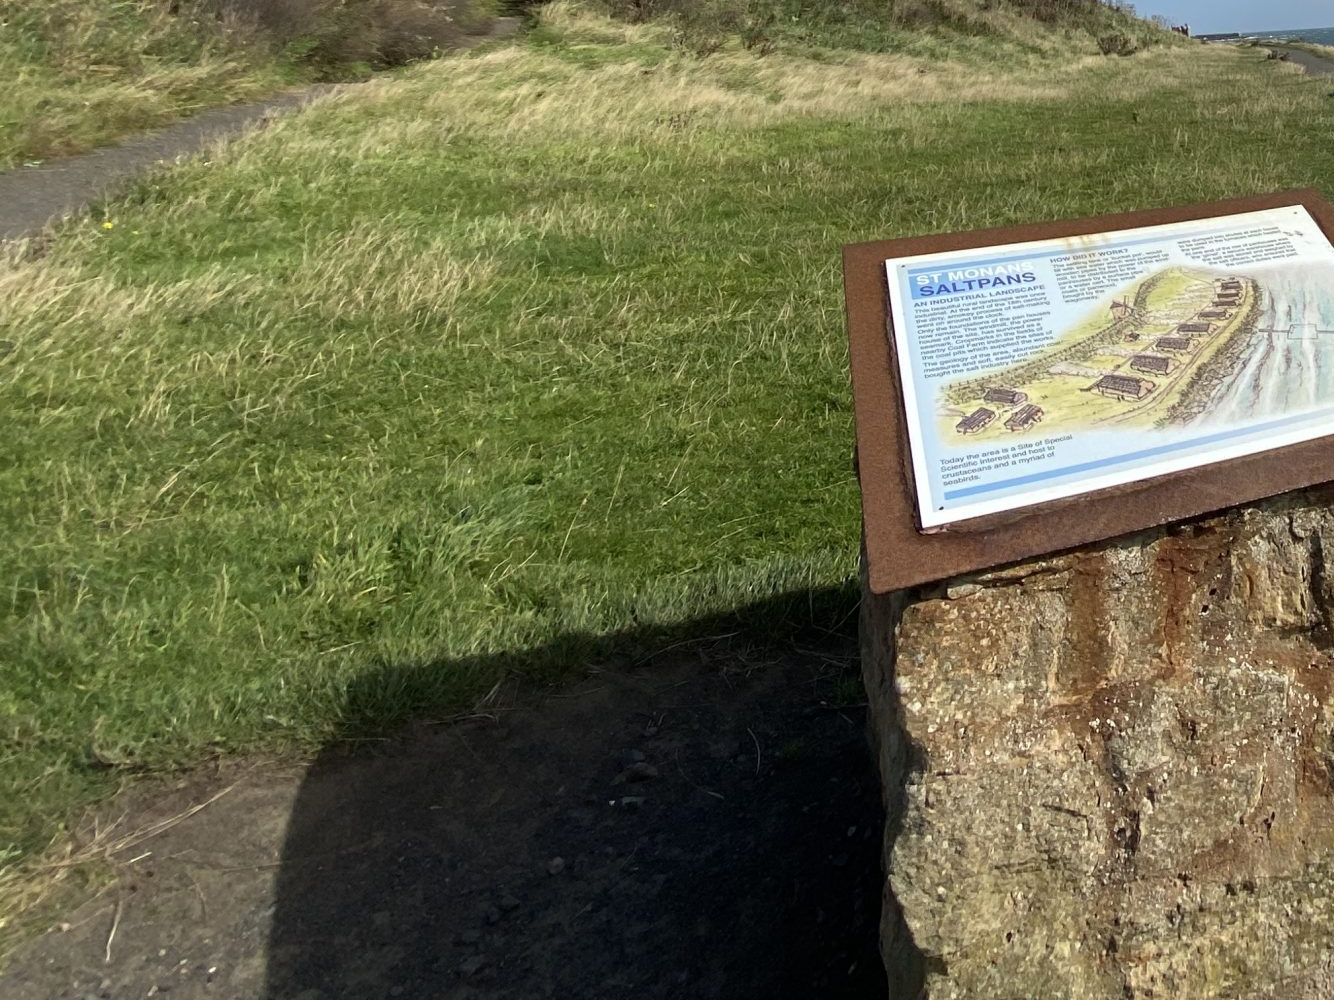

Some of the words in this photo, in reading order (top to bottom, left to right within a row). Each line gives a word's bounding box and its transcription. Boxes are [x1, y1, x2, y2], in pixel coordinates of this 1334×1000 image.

[916, 273, 943, 285] ST
[948, 262, 1035, 281] MONANS
[919, 272, 1036, 297] SALTPANS
[930, 293, 988, 305] INDUSTRIAL
[989, 284, 1046, 296] LANDSCAPE
[940, 456, 965, 466] Today
[981, 449, 1000, 457] area
[1017, 442, 1033, 450] Site
[1044, 434, 1073, 445] Special
[941, 460, 978, 472] Scientific
[980, 454, 1010, 464] interest
[1011, 450, 1027, 458] and
[942, 465, 992, 479] crustaceans
[1018, 454, 1046, 464] myriad
[943, 473, 981, 486] seabirds.
